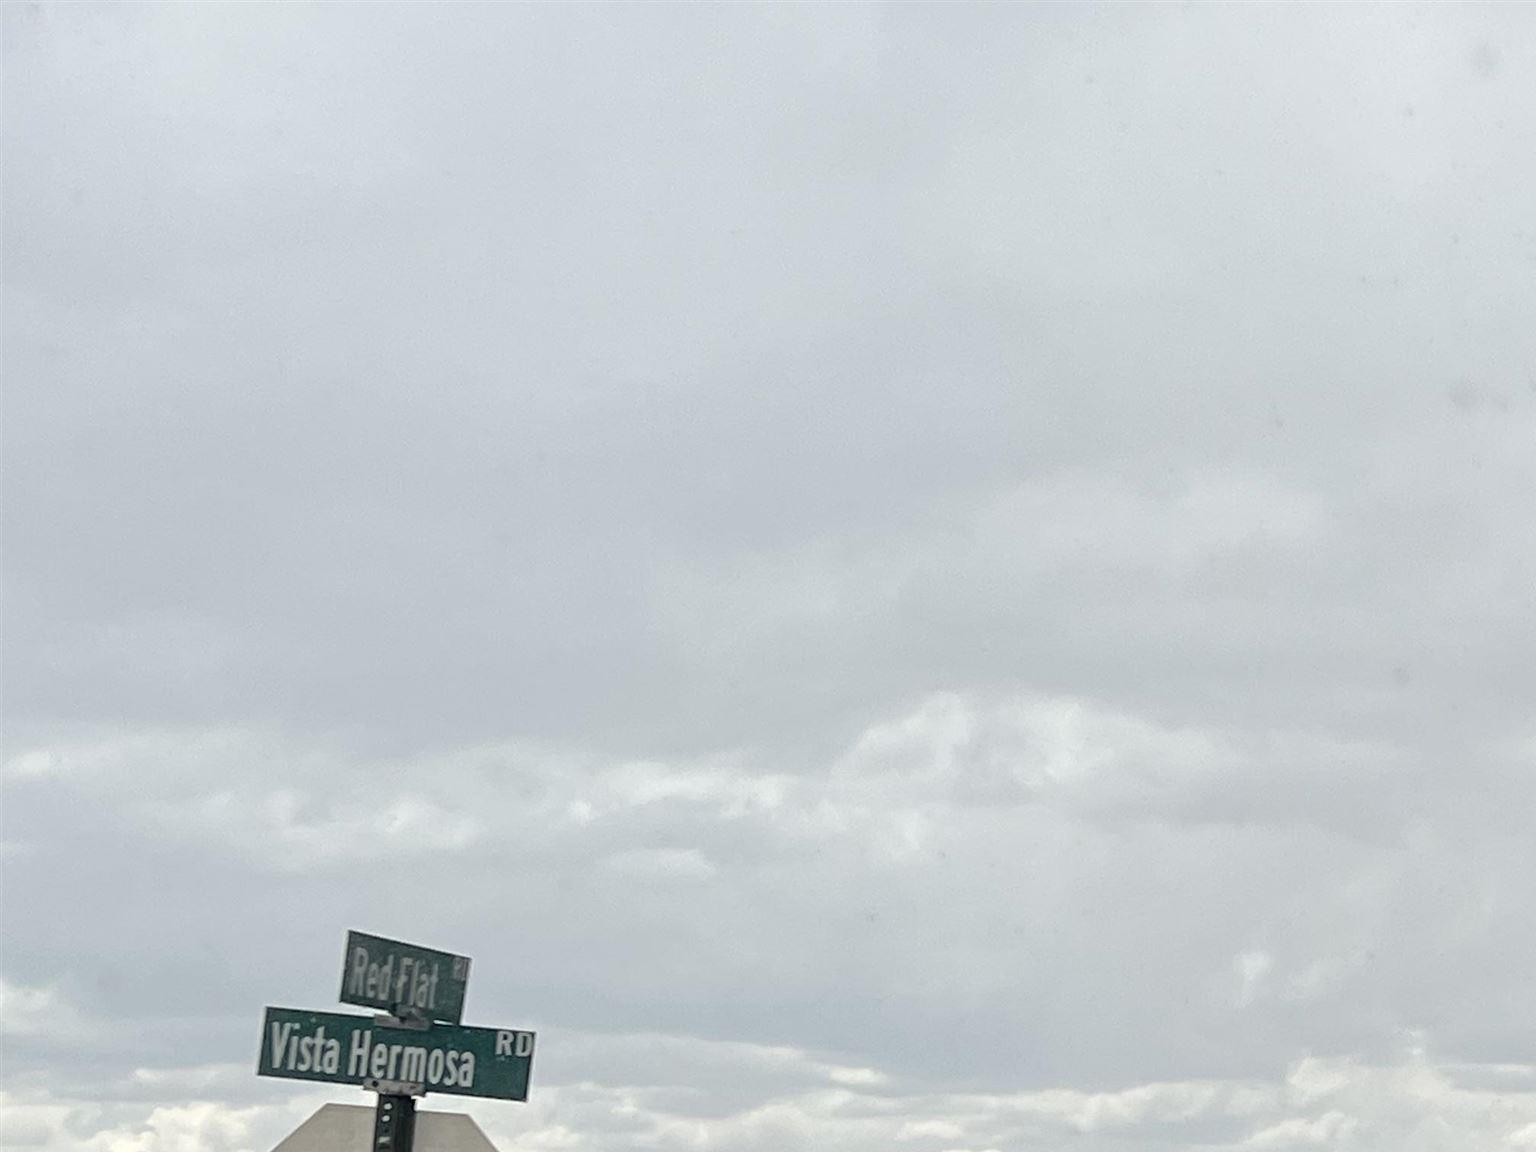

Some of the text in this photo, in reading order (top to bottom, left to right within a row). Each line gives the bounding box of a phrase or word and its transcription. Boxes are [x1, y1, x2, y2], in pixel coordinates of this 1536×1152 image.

[350, 947, 394, 1001] Red
[396, 957, 438, 1009] Flat
[271, 1022, 533, 1087] Vista Hermosa RD
